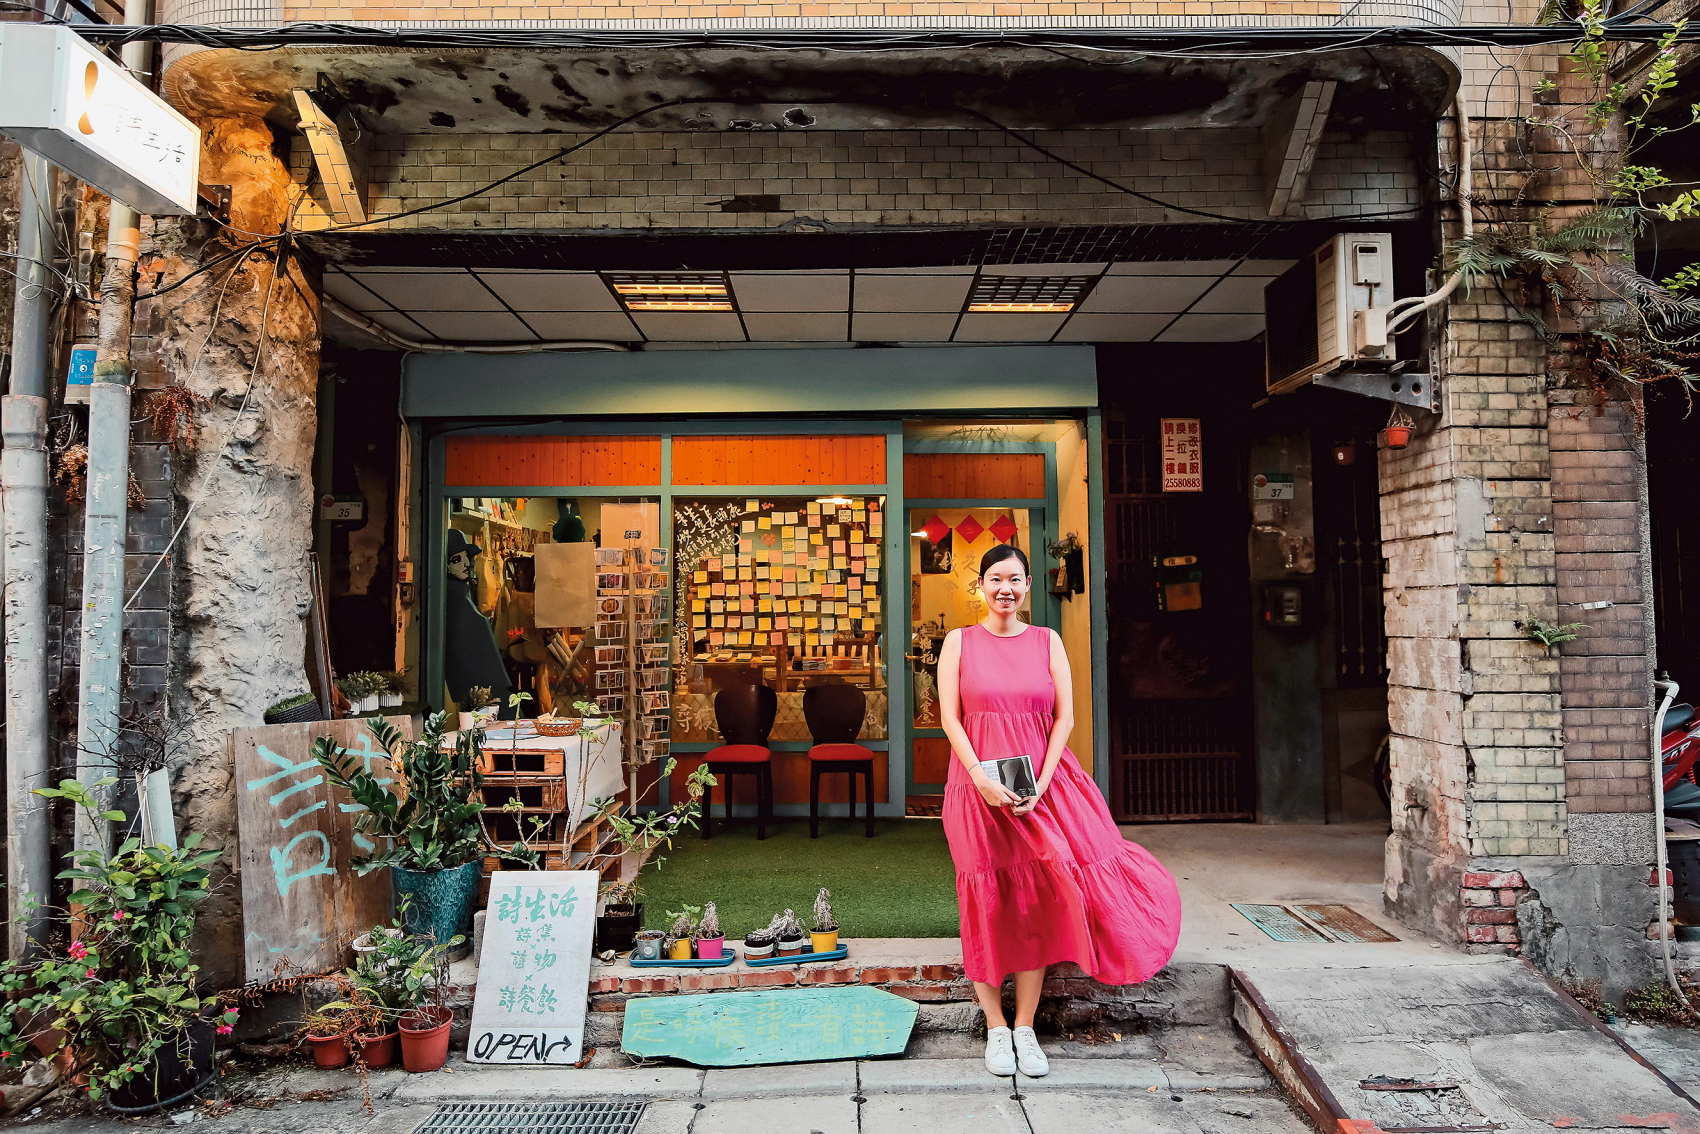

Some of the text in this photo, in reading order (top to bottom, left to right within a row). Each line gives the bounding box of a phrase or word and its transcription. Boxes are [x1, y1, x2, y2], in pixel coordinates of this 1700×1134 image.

[1164, 422, 1175, 474] 請上二樓
[1188, 422, 1199, 474] 修改衣服
[1165, 478, 1200, 488] 25580883
[1271, 489, 1282, 497] 37
[338, 508, 350, 518] 35
[494, 885, 579, 924] 詩生活
[514, 922, 558, 945] 詩集
[498, 982, 559, 1016] 詩餐飲
[629, 996, 897, 1051] 是時候讀一首詩
